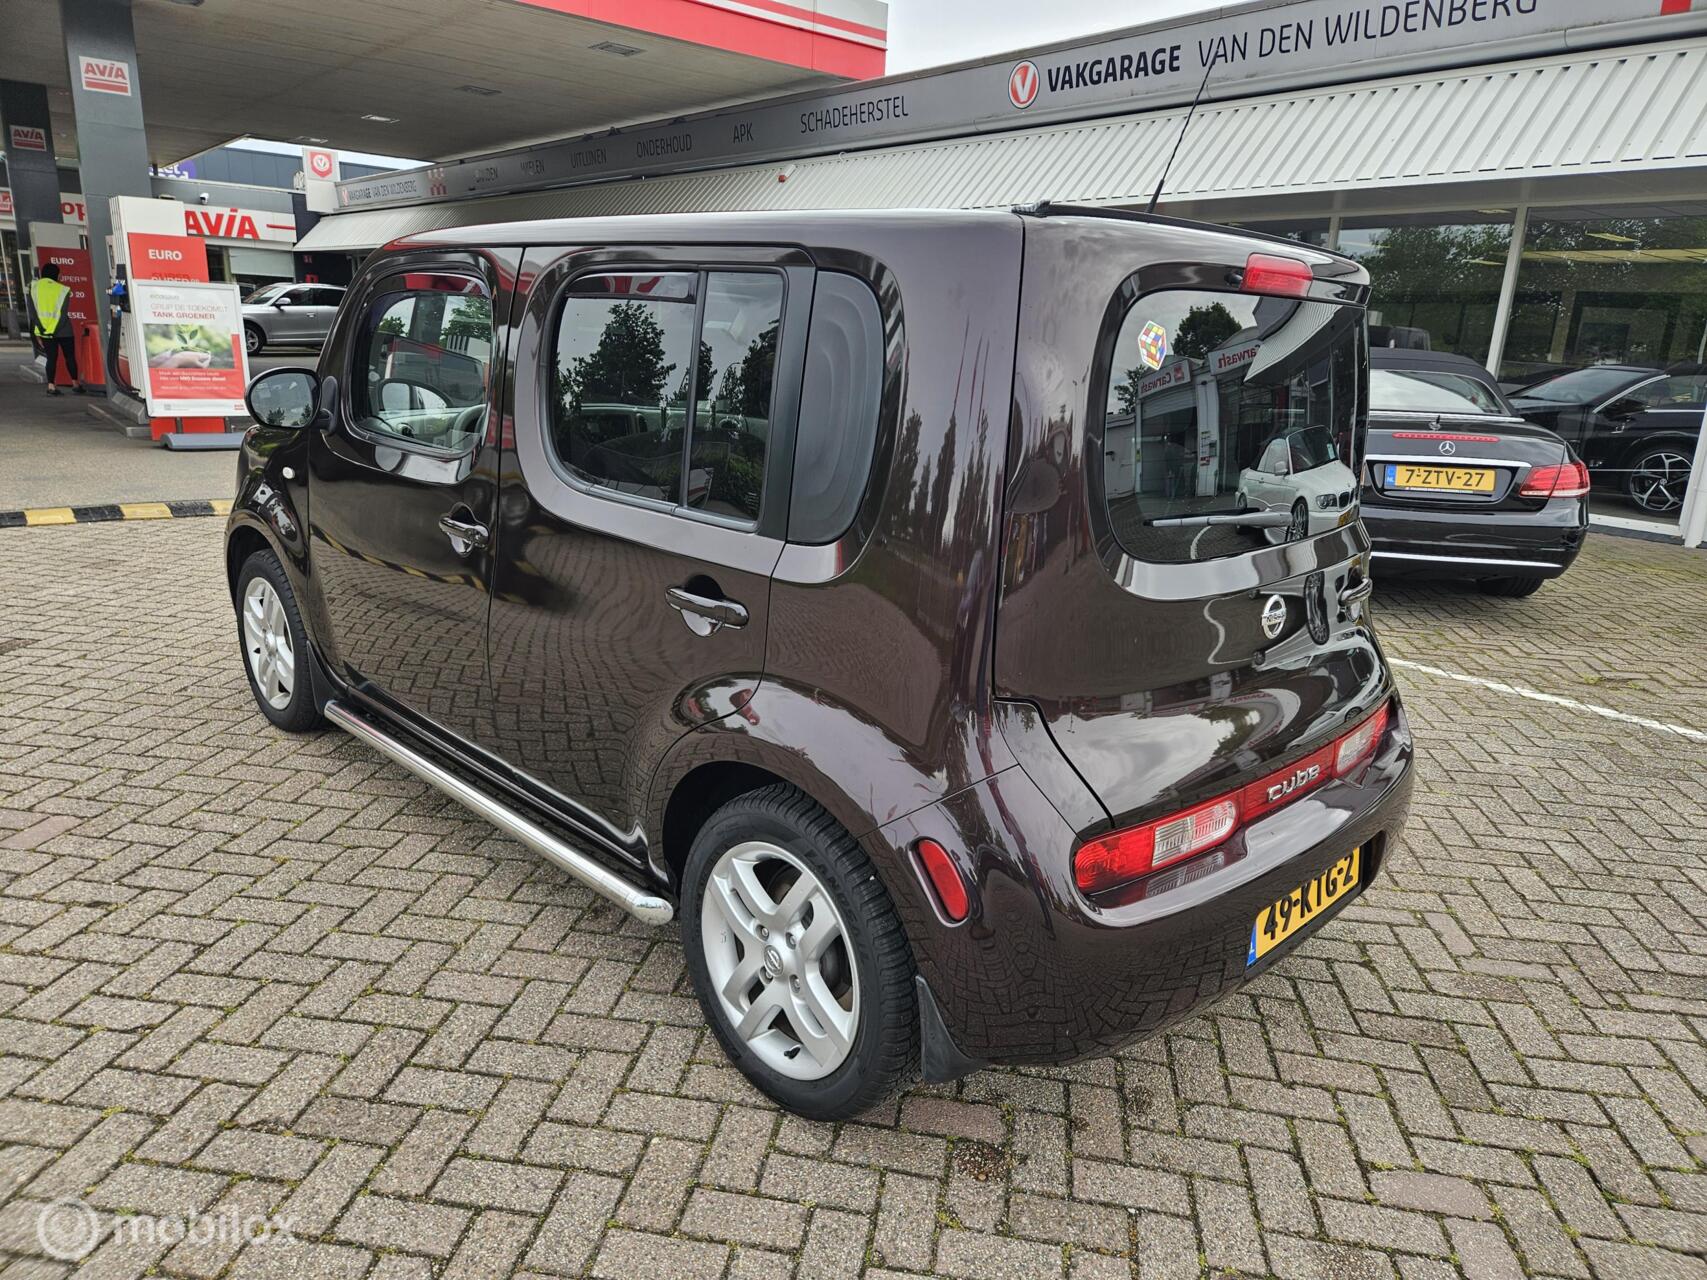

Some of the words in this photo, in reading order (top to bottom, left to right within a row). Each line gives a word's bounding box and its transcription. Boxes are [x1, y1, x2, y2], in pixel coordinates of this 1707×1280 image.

[1048, 45, 1181, 92] VAKGARAGE
[1199, 32, 1247, 68] VAN
[1259, 20, 1313, 57] DEN
[84, 61, 128, 81] AVIA
[801, 96, 908, 133] SCHADEHERSTEL
[13, 128, 44, 141] AVIA
[733, 122, 755, 144] APK
[636, 133, 693, 159] ONDERHOUD
[184, 208, 260, 240] AVIA
[51, 257, 75, 265] EURO
[148, 249, 183, 261] EURO
[67, 311, 87, 320] ESEL
[176, 312, 216, 320] GROENER
[1267, 763, 1321, 802] cube
[1263, 851, 1354, 941] 49-KTG-2
